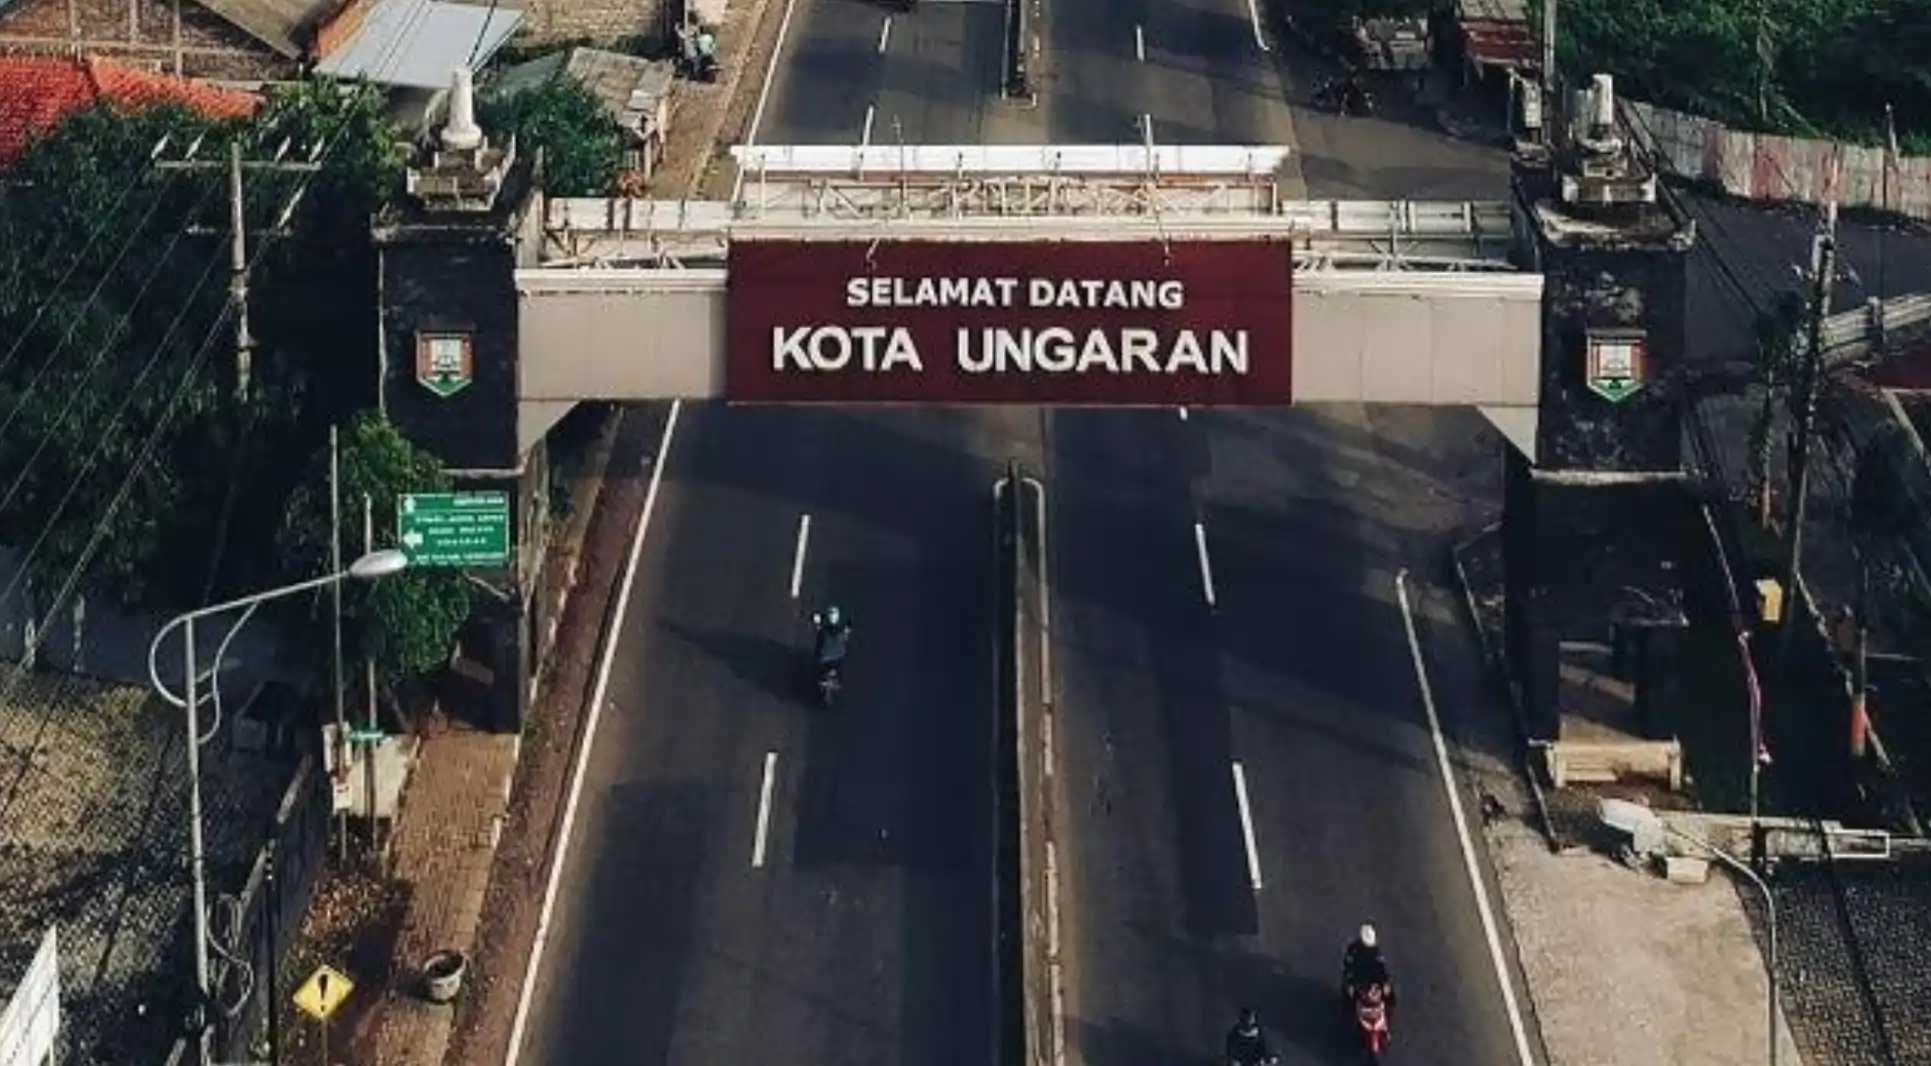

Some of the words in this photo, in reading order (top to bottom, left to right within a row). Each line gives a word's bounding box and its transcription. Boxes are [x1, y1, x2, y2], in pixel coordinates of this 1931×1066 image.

[846, 277, 1019, 307] SELAMAT
[1029, 279, 1184, 309] DATANG
[772, 325, 923, 372] KOTA
[957, 327, 1249, 374] UNGARAN
